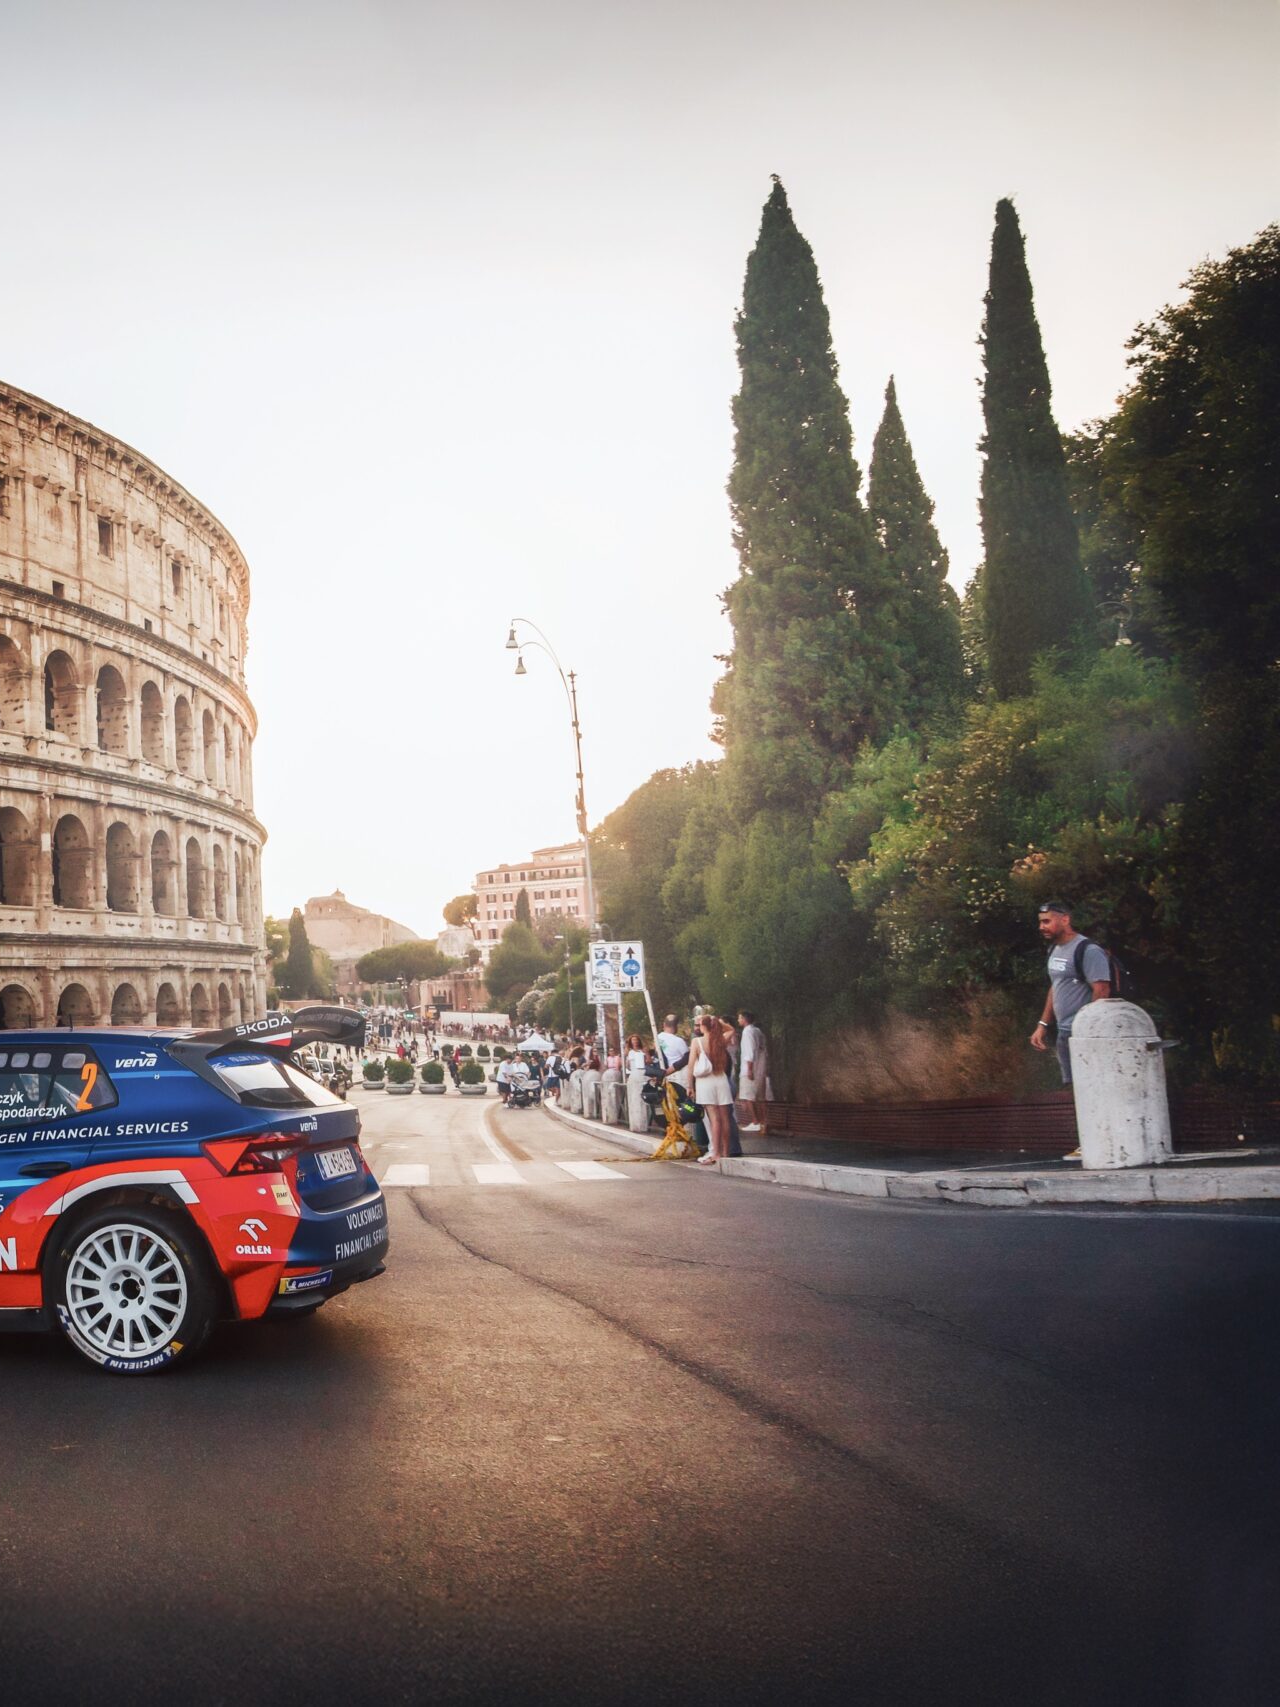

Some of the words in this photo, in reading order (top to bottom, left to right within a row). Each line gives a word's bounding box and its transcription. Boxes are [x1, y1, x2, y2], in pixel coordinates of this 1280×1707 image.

[76, 1063, 98, 1112] 2
[32, 1127, 111, 1142] FINANCIAL
[116, 1121, 189, 1136] SERVICES
[346, 1203, 384, 1230] VOLKSWAGEN
[235, 1245, 271, 1255] ORLEN
[335, 1233, 372, 1261] FINANCIAL
[109, 1353, 164, 1370] MICHELIN
